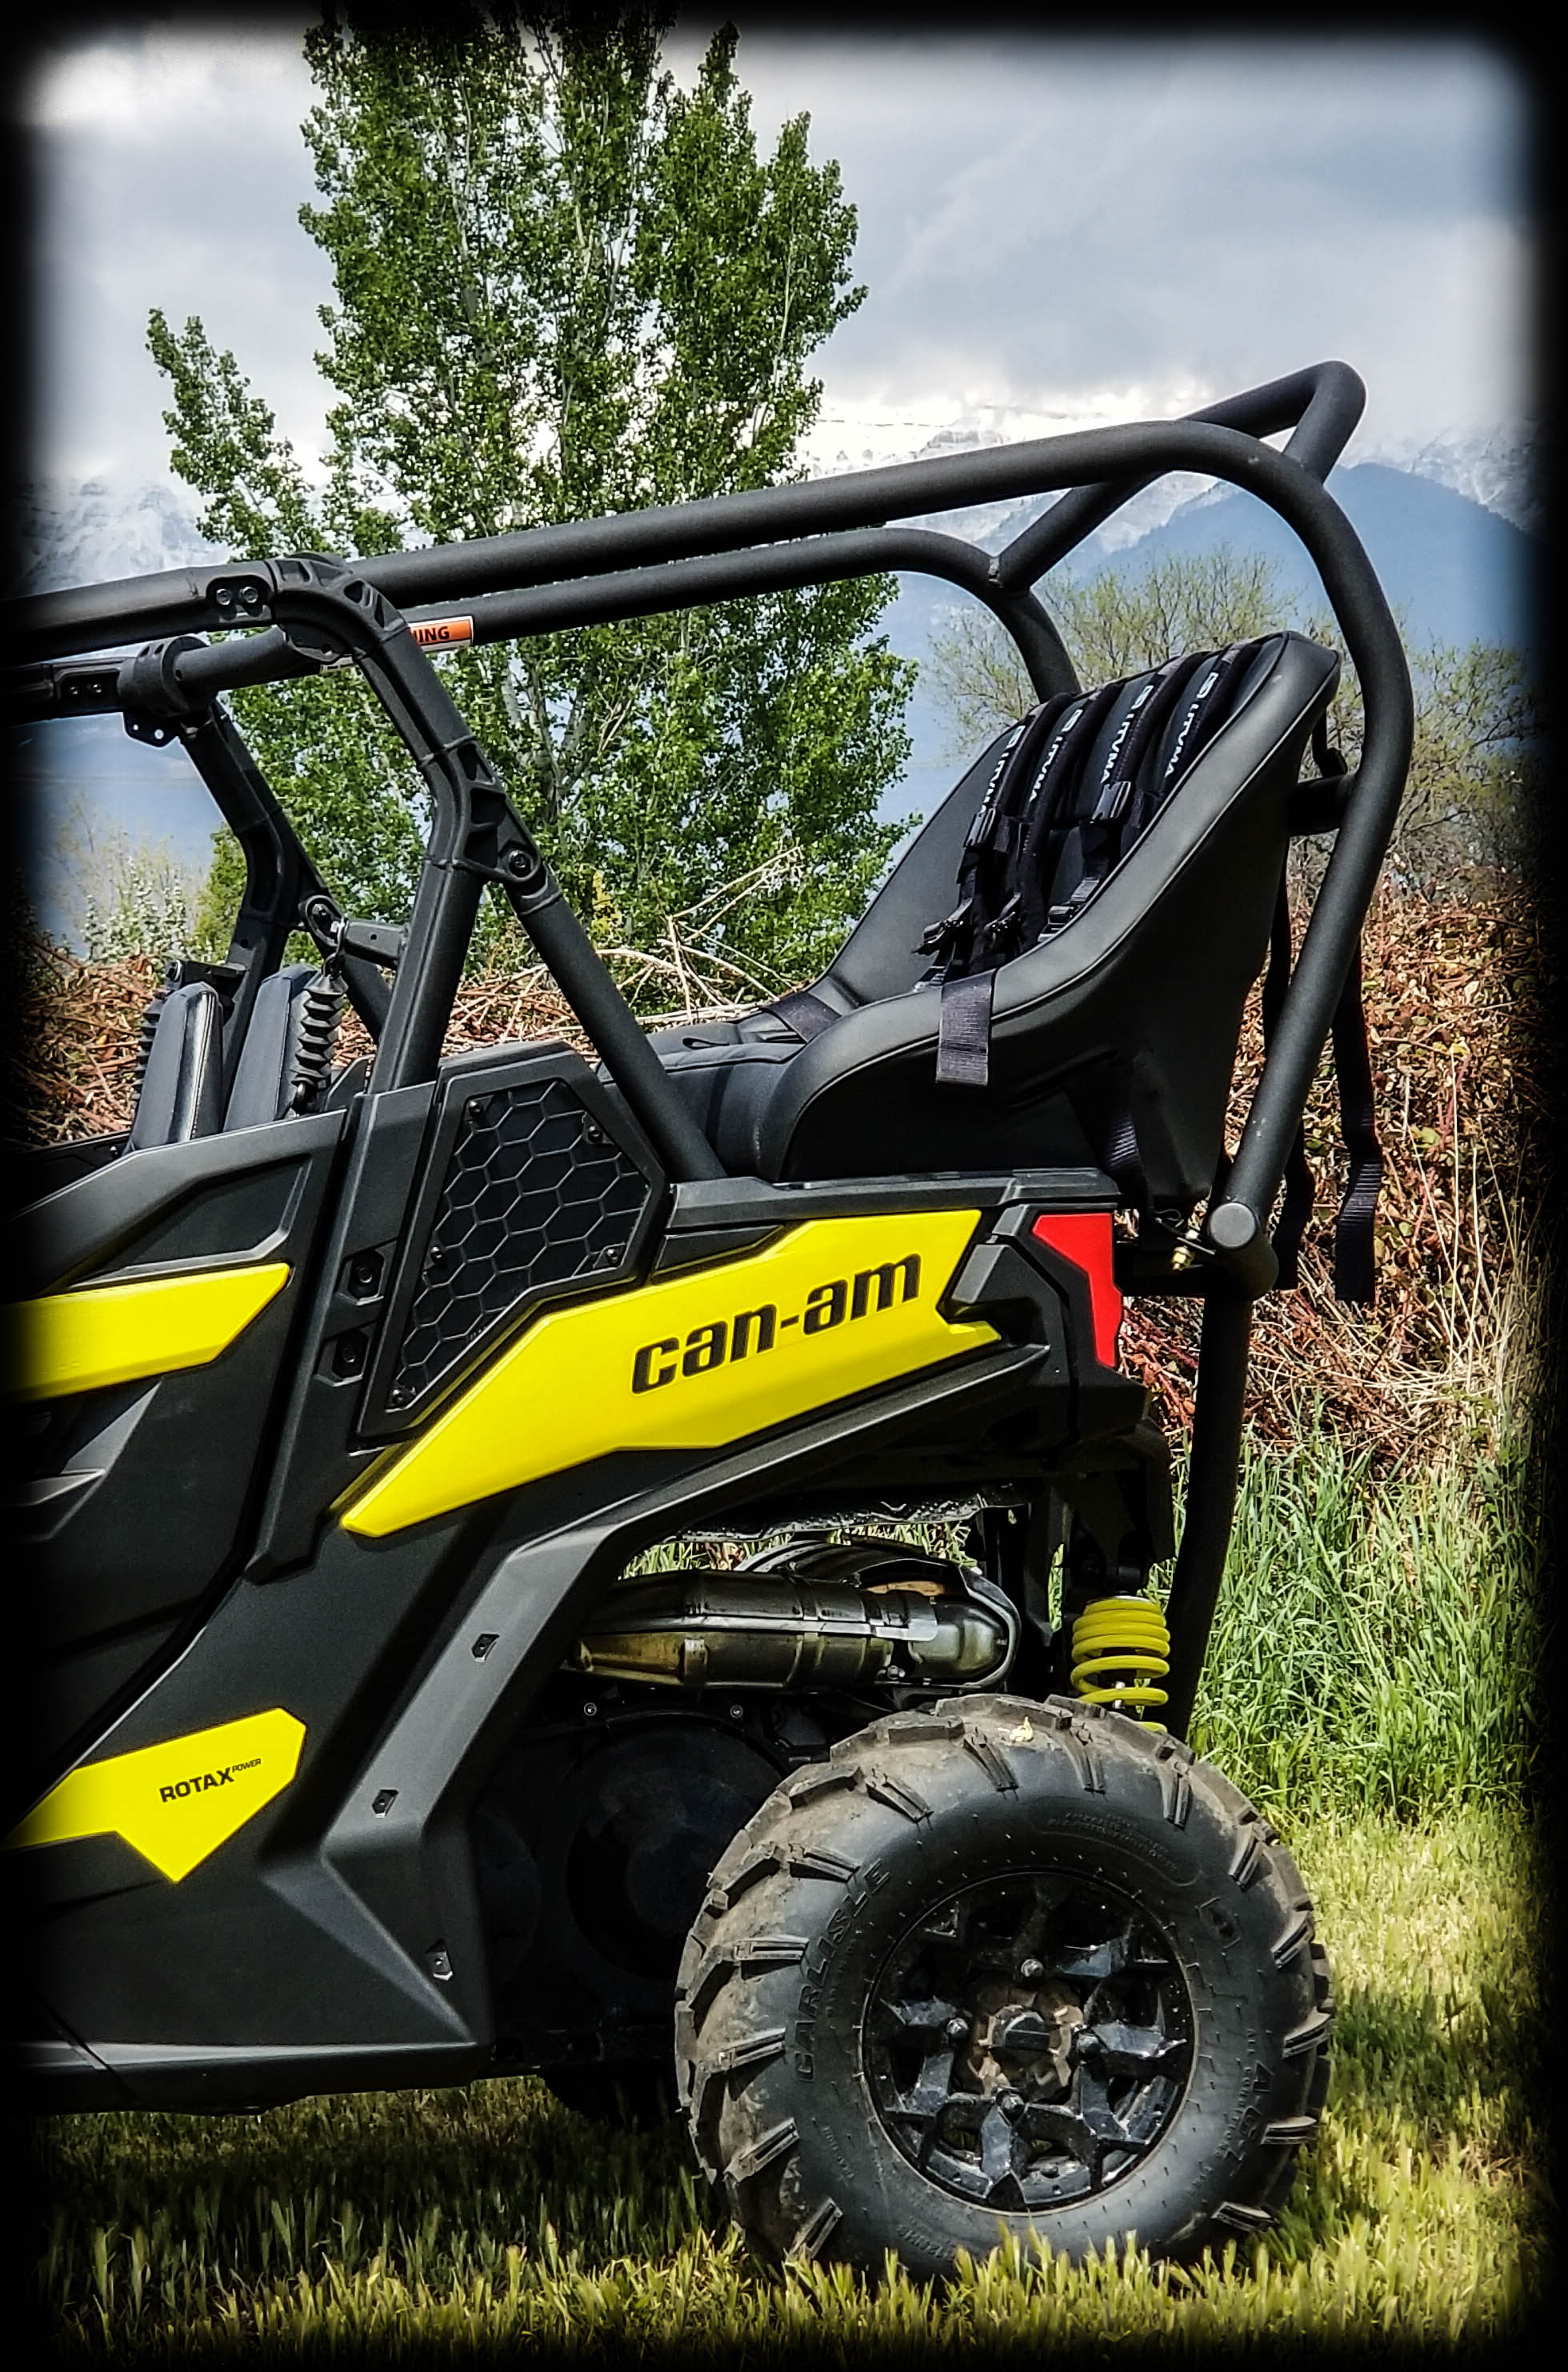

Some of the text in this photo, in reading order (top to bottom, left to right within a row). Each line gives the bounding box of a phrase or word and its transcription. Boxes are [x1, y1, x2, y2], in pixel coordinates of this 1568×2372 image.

[631, 1253, 922, 1394] can-am
[159, 1758, 262, 1803] ROTAX POWER
[794, 1858, 890, 2082] CARLISLE
